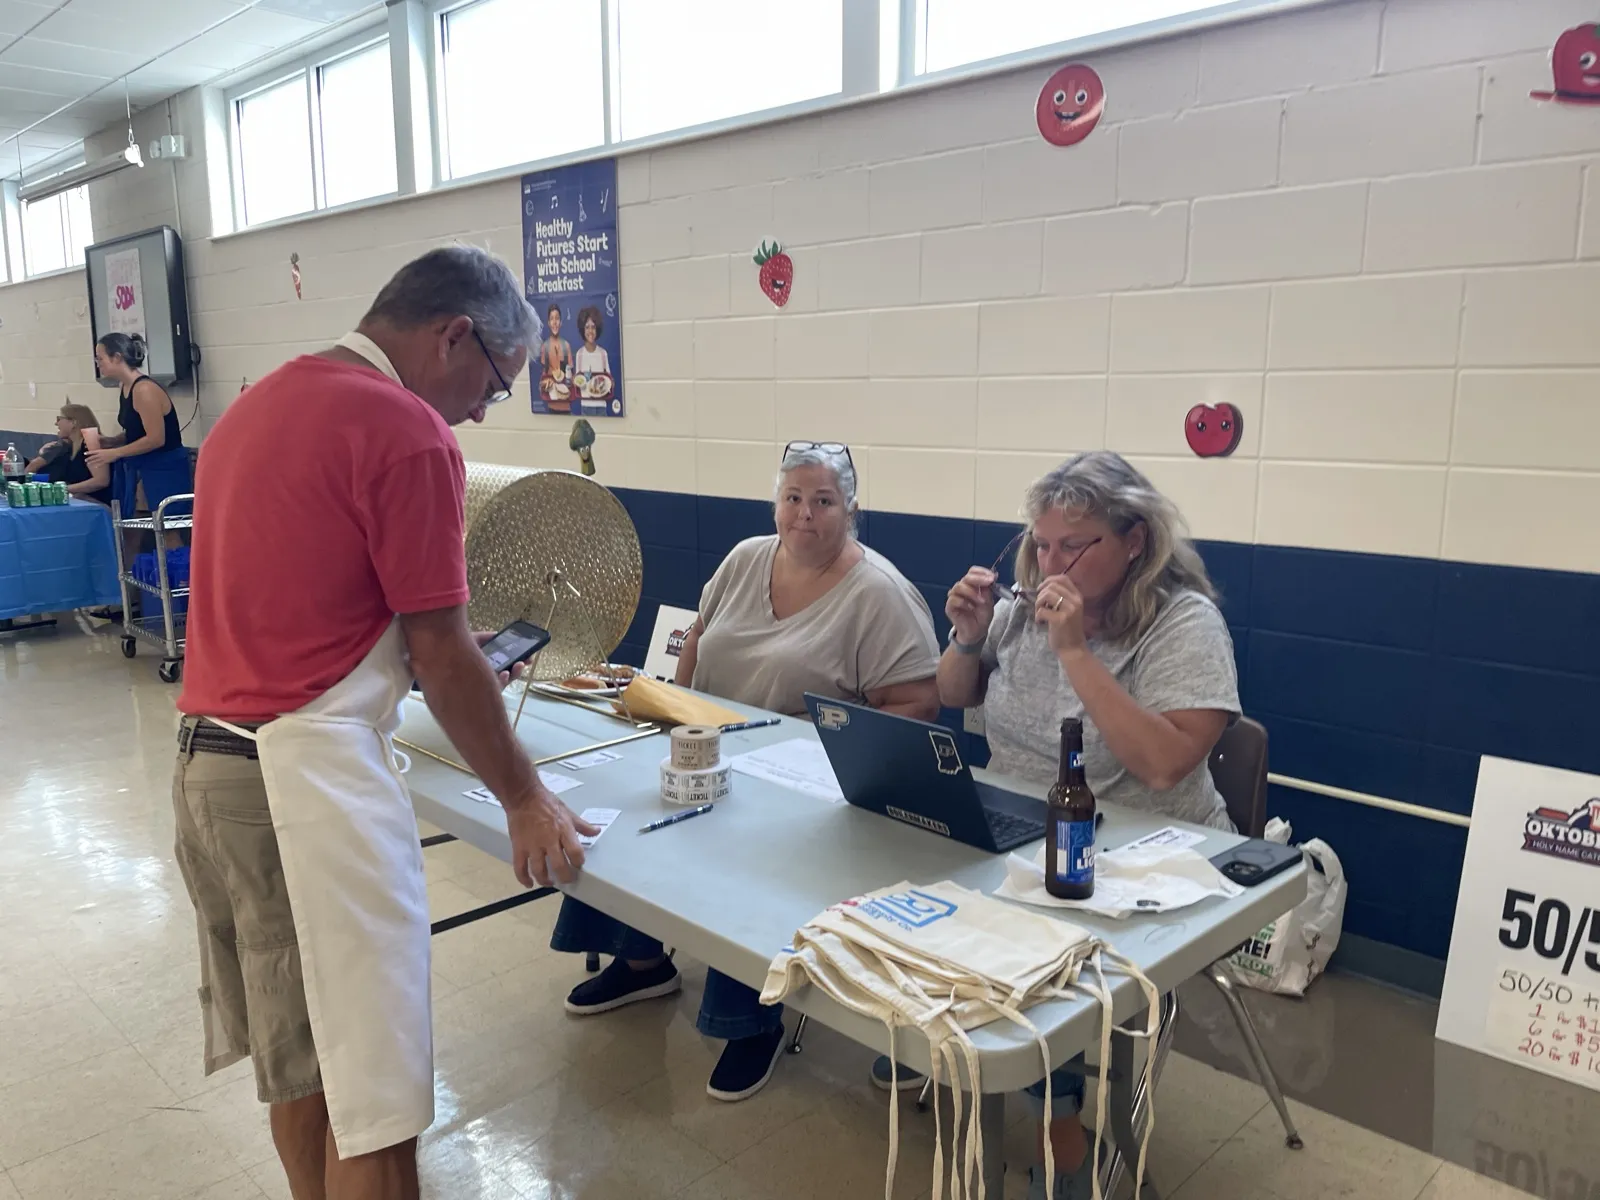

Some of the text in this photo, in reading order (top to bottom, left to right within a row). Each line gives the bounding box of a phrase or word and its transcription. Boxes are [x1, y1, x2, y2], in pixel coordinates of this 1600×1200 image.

[536, 218, 573, 239] Healthy
[537, 232, 609, 258] Futures Start
[537, 253, 596, 276] with School
[538, 274, 584, 293] Breakfast
[689, 792, 708, 801] TICKET
[1533, 840, 1554, 851] HOLY
[1555, 845, 1578, 856] NAME
[1499, 969, 1572, 1004] 50/50
[1528, 1003, 1545, 1020] 1
[1528, 1020, 1542, 1036] 6
[1518, 1037, 1544, 1058] 20
